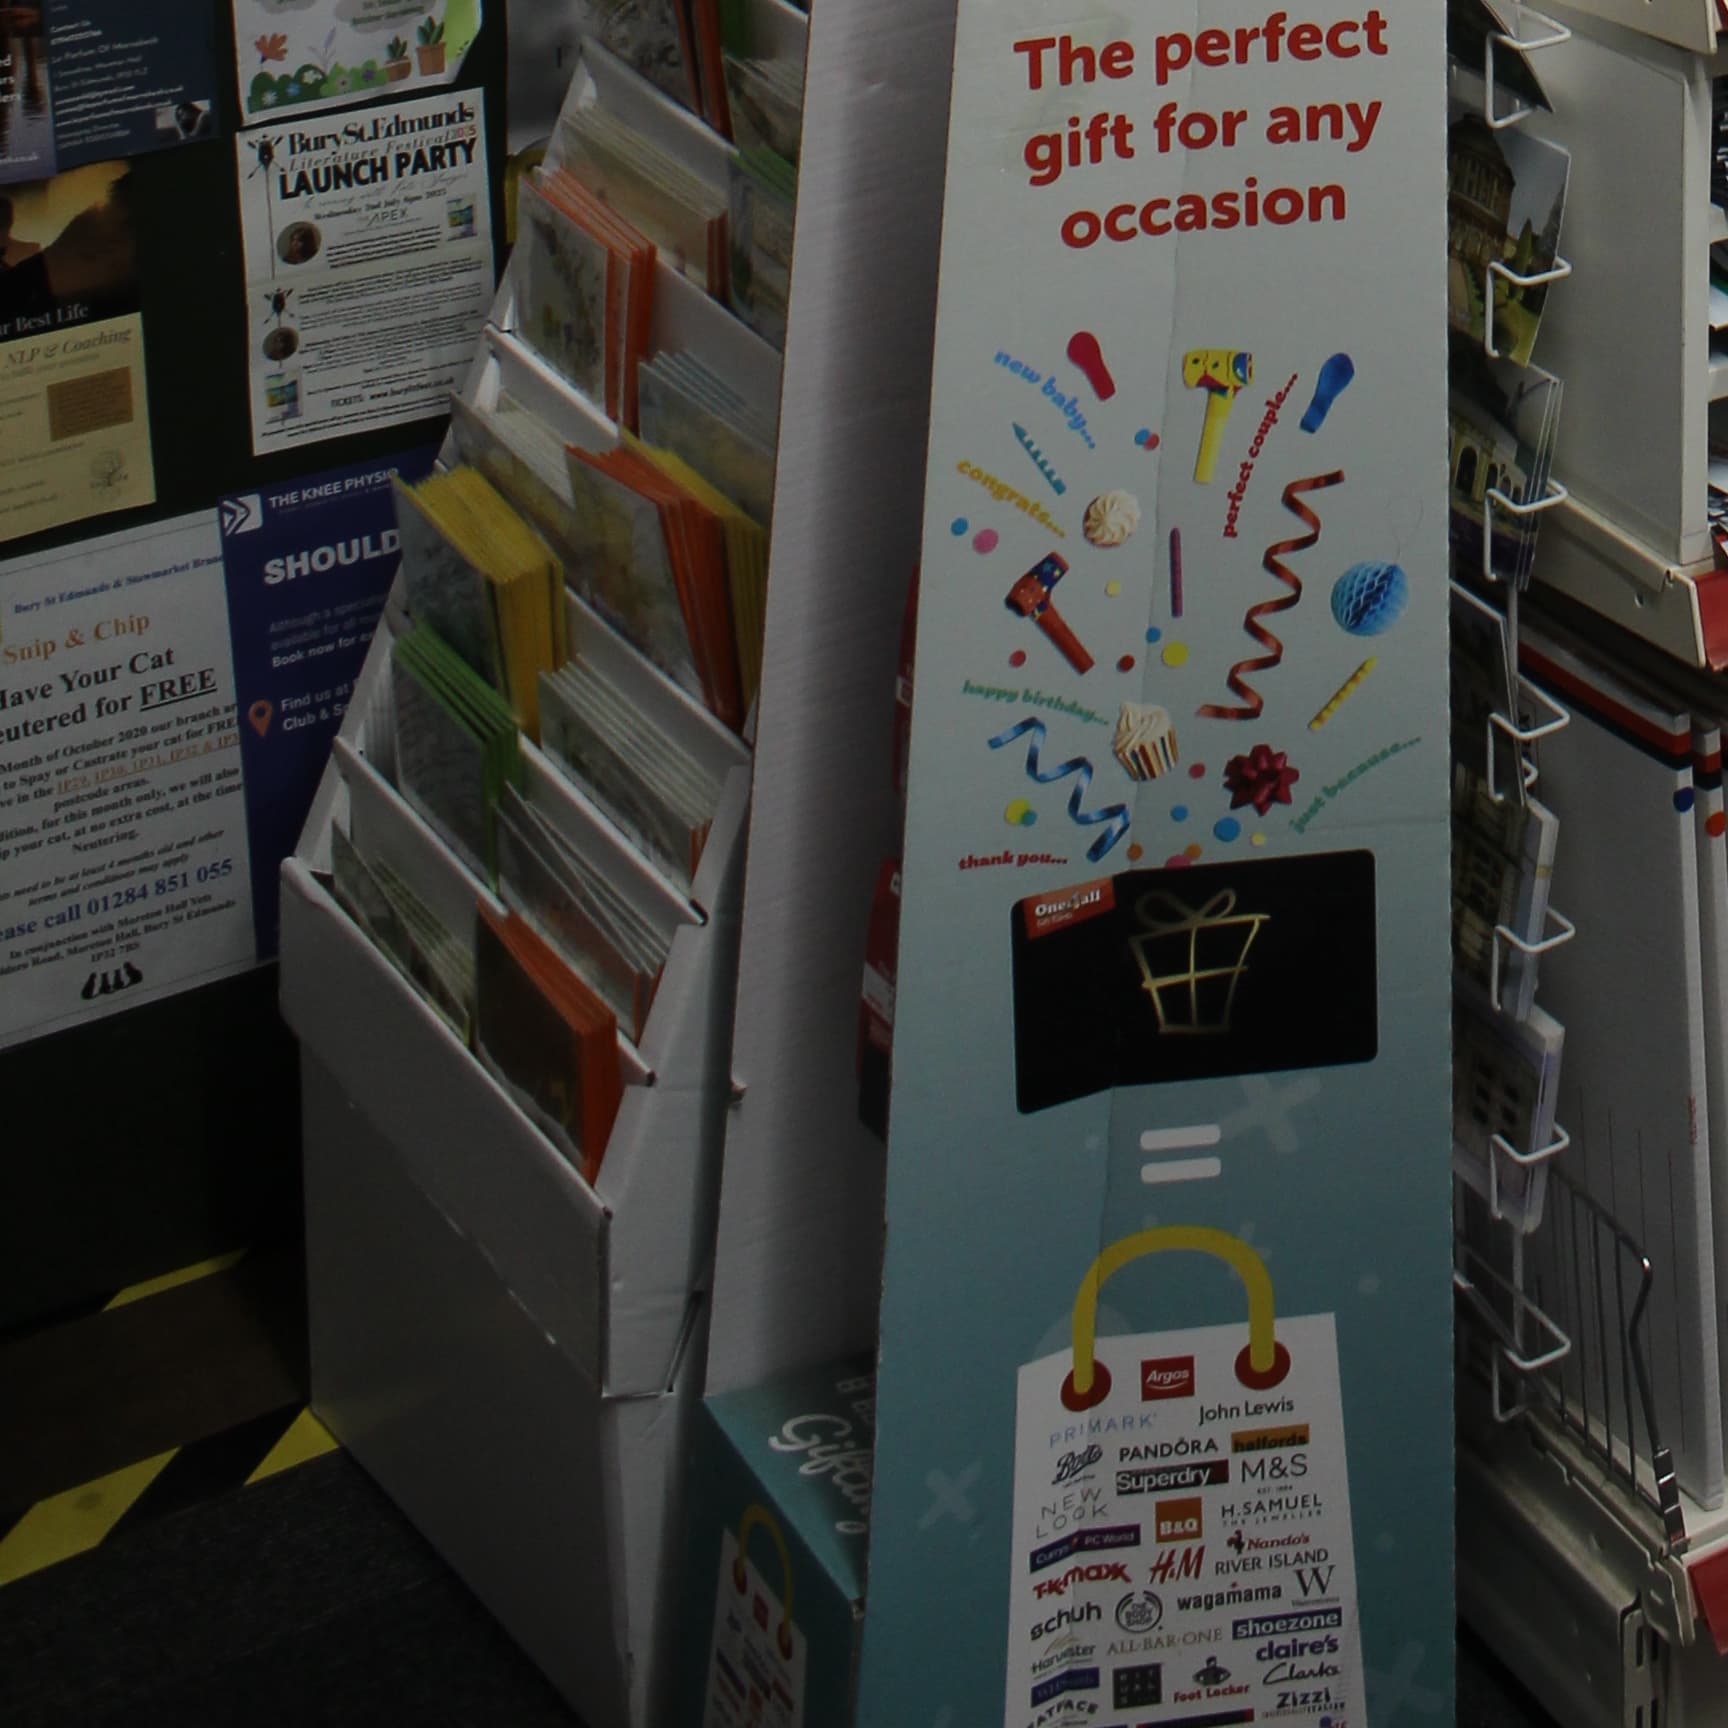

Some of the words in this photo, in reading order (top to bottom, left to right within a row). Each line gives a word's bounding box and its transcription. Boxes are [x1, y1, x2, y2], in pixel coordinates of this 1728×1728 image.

[1013, 34, 1135, 91] The
[1154, 9, 1390, 86] perfect
[1023, 111, 1135, 187] gift
[1153, 101, 1248, 155] for
[1265, 99, 1383, 153] any
[278, 152, 389, 201] LAUNCH
[395, 138, 478, 176] PARTY
[1059, 176, 1347, 250] occasion
[301, 482, 340, 501] KNEE
[3, 636, 56, 666] Snip
[93, 612, 151, 644] Chip
[59, 655, 122, 694] Your
[128, 646, 175, 675] Cat
[95, 695, 132, 719] for
[139, 667, 218, 711] FREE
[87, 883, 148, 916] 01284
[155, 873, 190, 897] 851
[196, 858, 233, 884] 055
[1146, 1368, 1191, 1385] Argos
[1199, 1402, 1241, 1426] John
[1244, 1396, 1294, 1417] Lewis
[1048, 1415, 1153, 1448] PRIMARK
[1116, 1466, 1211, 1493] Superdry
[1241, 1453, 1309, 1483] M&S
[1215, 1554, 1262, 1576] RIVER
[1268, 1548, 1330, 1570] ISLAND
[1177, 1582, 1283, 1612] wagamama
[1031, 1602, 1103, 1641] schuh
[1236, 1612, 1340, 1640] shoezone
[1256, 1634, 1339, 1662] claire's
